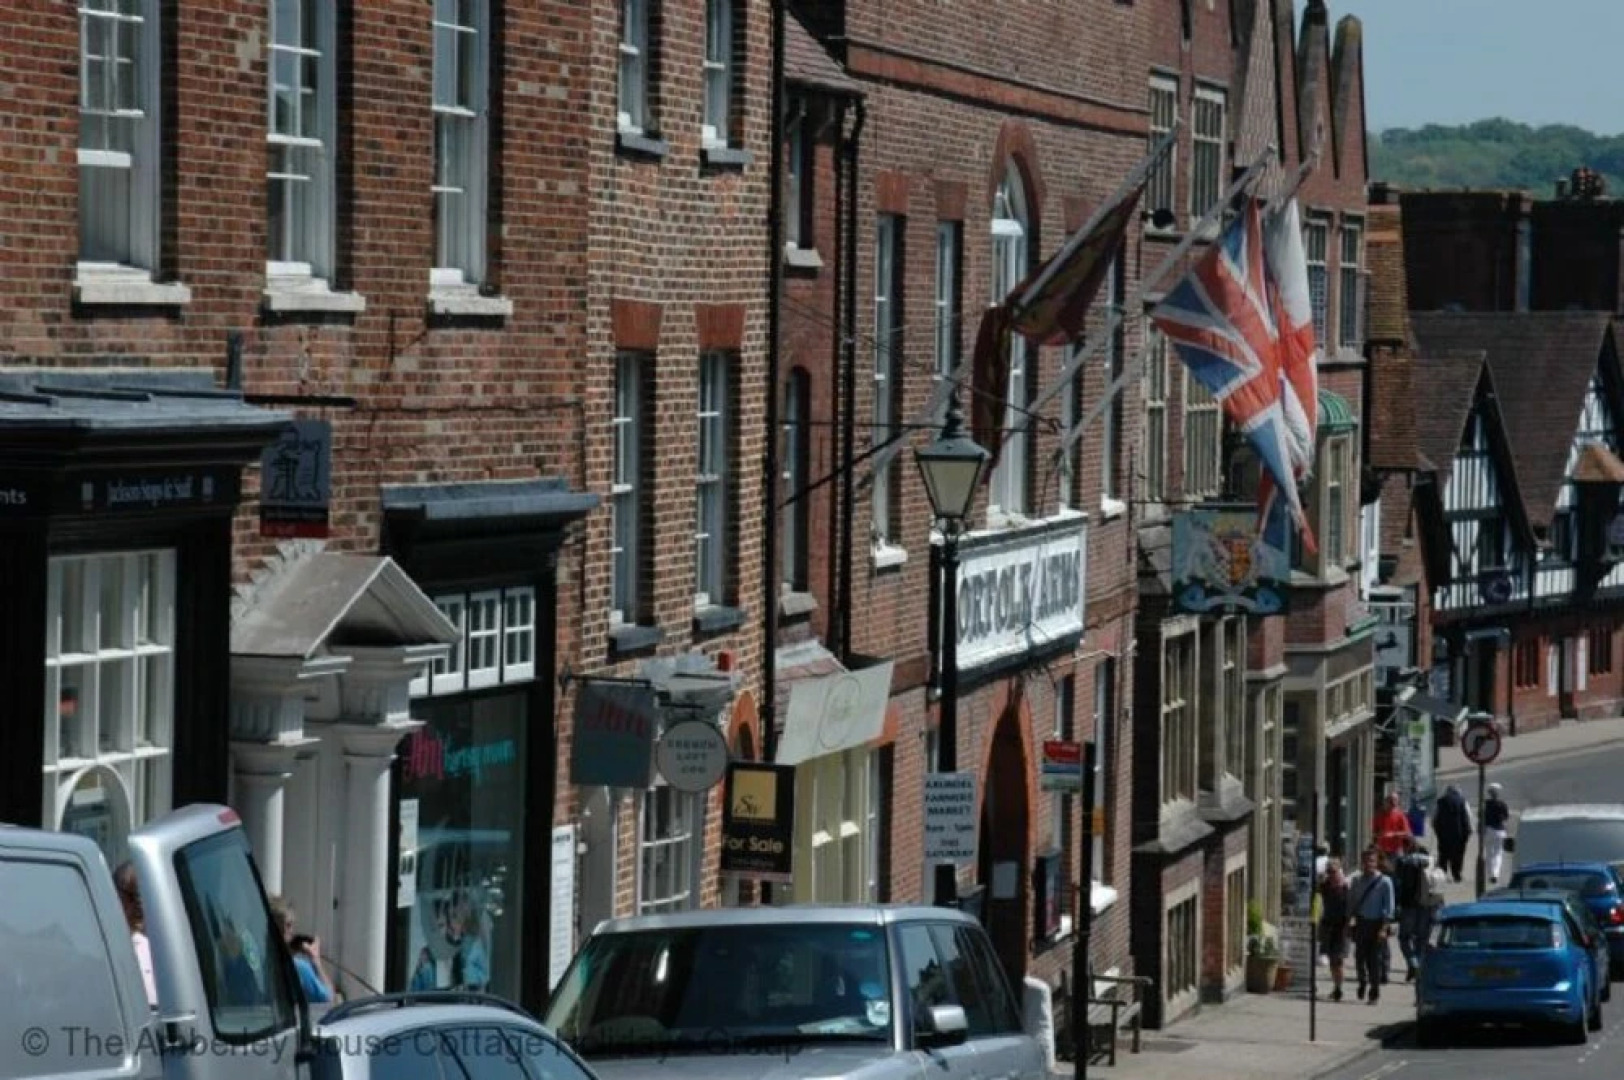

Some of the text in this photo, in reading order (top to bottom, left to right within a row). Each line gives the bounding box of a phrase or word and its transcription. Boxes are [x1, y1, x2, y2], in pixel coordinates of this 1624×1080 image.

[957, 561, 1032, 643] ORFOLK
[925, 780, 972, 788] ARUNDEL
[925, 793, 973, 802] FARMERS
[928, 806, 971, 816] MARKET
[722, 835, 783, 854] For Sale
